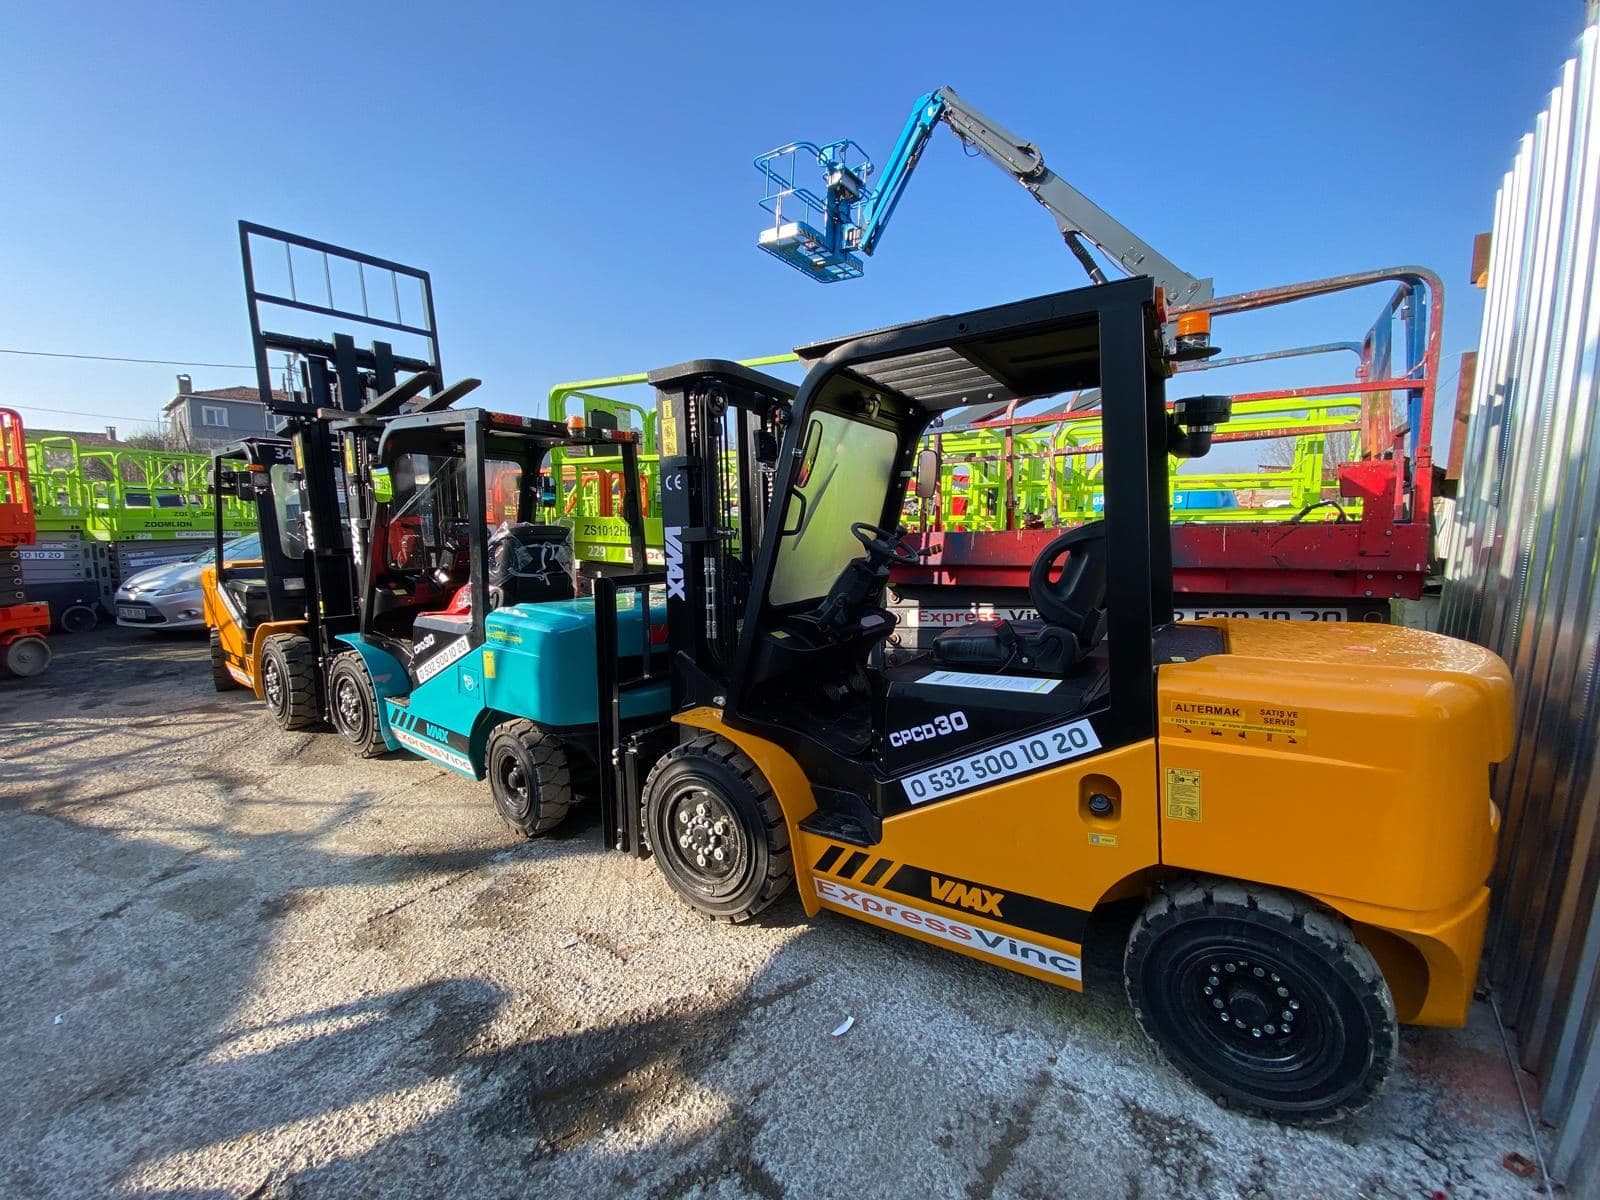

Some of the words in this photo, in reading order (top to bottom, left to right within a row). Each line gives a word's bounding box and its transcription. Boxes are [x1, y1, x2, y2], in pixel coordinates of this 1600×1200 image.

[918, 609, 1000, 626] Express
[1175, 703, 1240, 717] ALTERMAK
[1259, 708, 1285, 719] SATIŞ
[1287, 711, 1299, 719] VE
[888, 711, 969, 748] CPCD30
[1263, 717, 1296, 727] SERVİS
[910, 779, 926, 798] 0
[928, 765, 969, 792] 532
[971, 750, 1018, 779] 500
[1019, 739, 1049, 764] 10
[1052, 727, 1089, 754] 20
